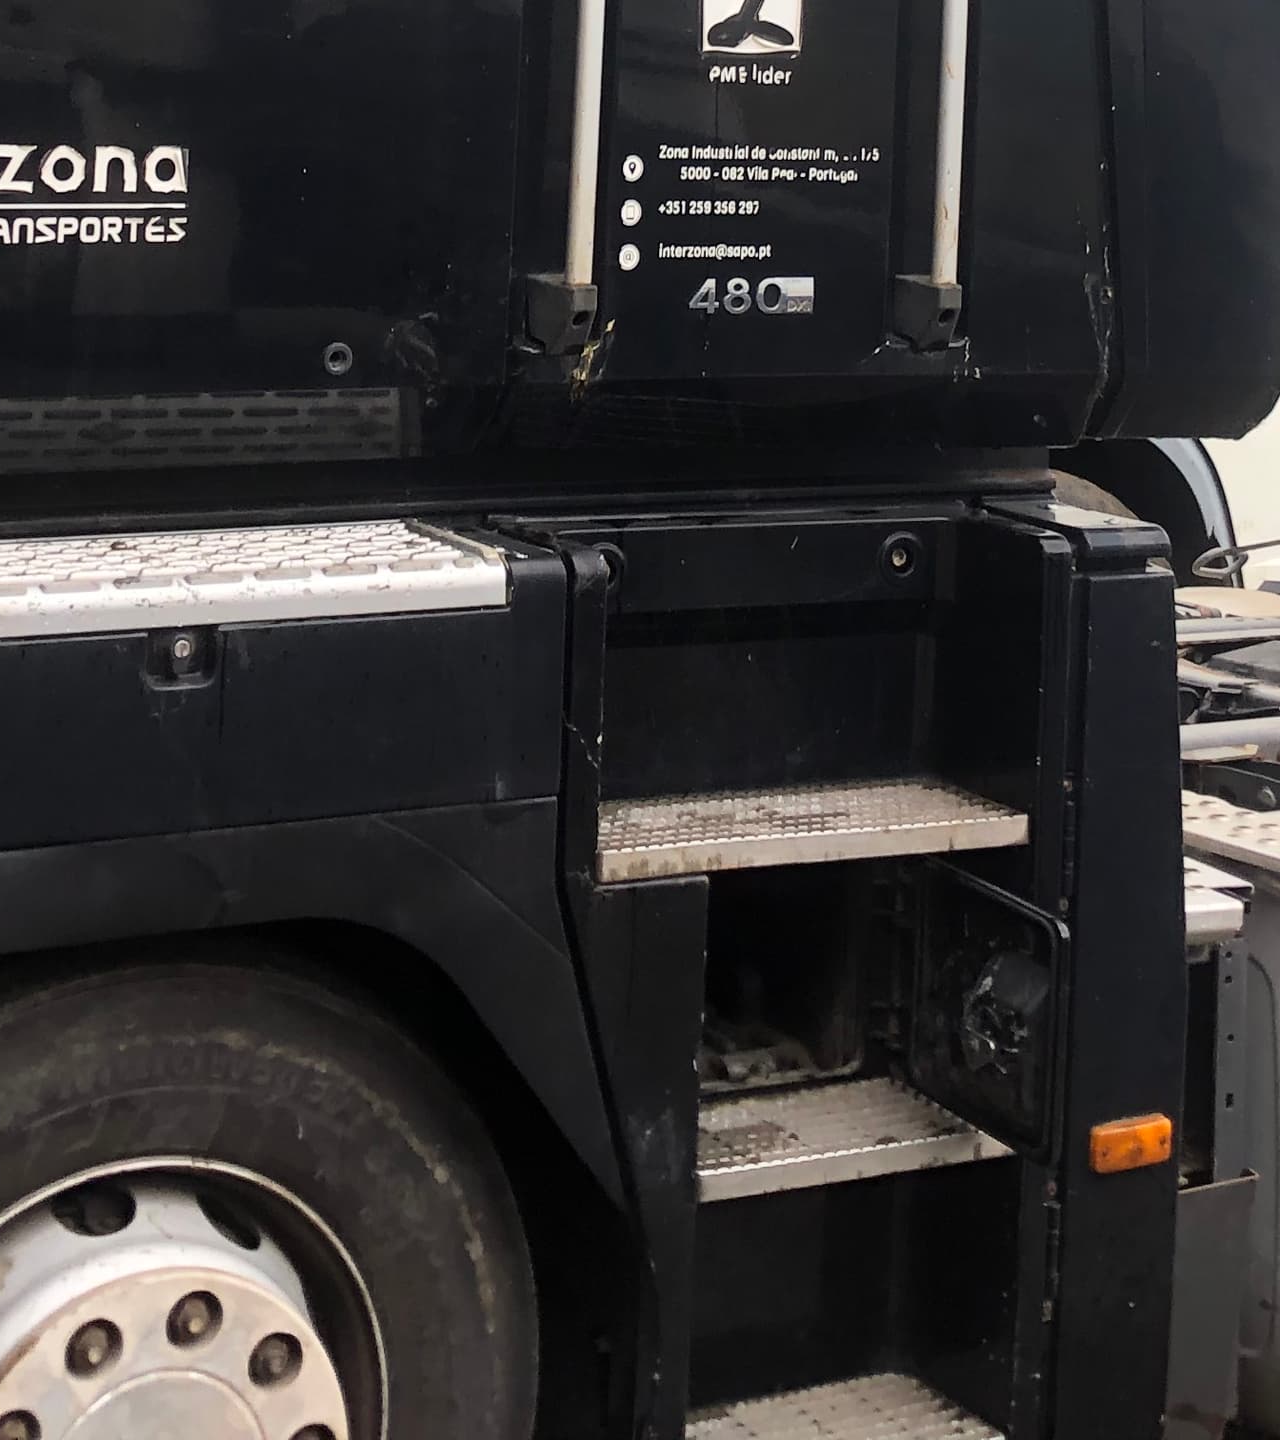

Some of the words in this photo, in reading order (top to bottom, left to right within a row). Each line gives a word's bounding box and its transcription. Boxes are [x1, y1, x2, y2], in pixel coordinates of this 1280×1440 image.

[709, 65, 748, 84] PME
[659, 144, 690, 160] Zona
[751, 145, 767, 160] de
[680, 166, 712, 180] 5000
[746, 165, 770, 181] Vila
[658, 200, 686, 215] +351
[738, 200, 760, 215] 297
[658, 242, 772, 260] interzona@sapo.pt
[688, 277, 785, 314] 480
